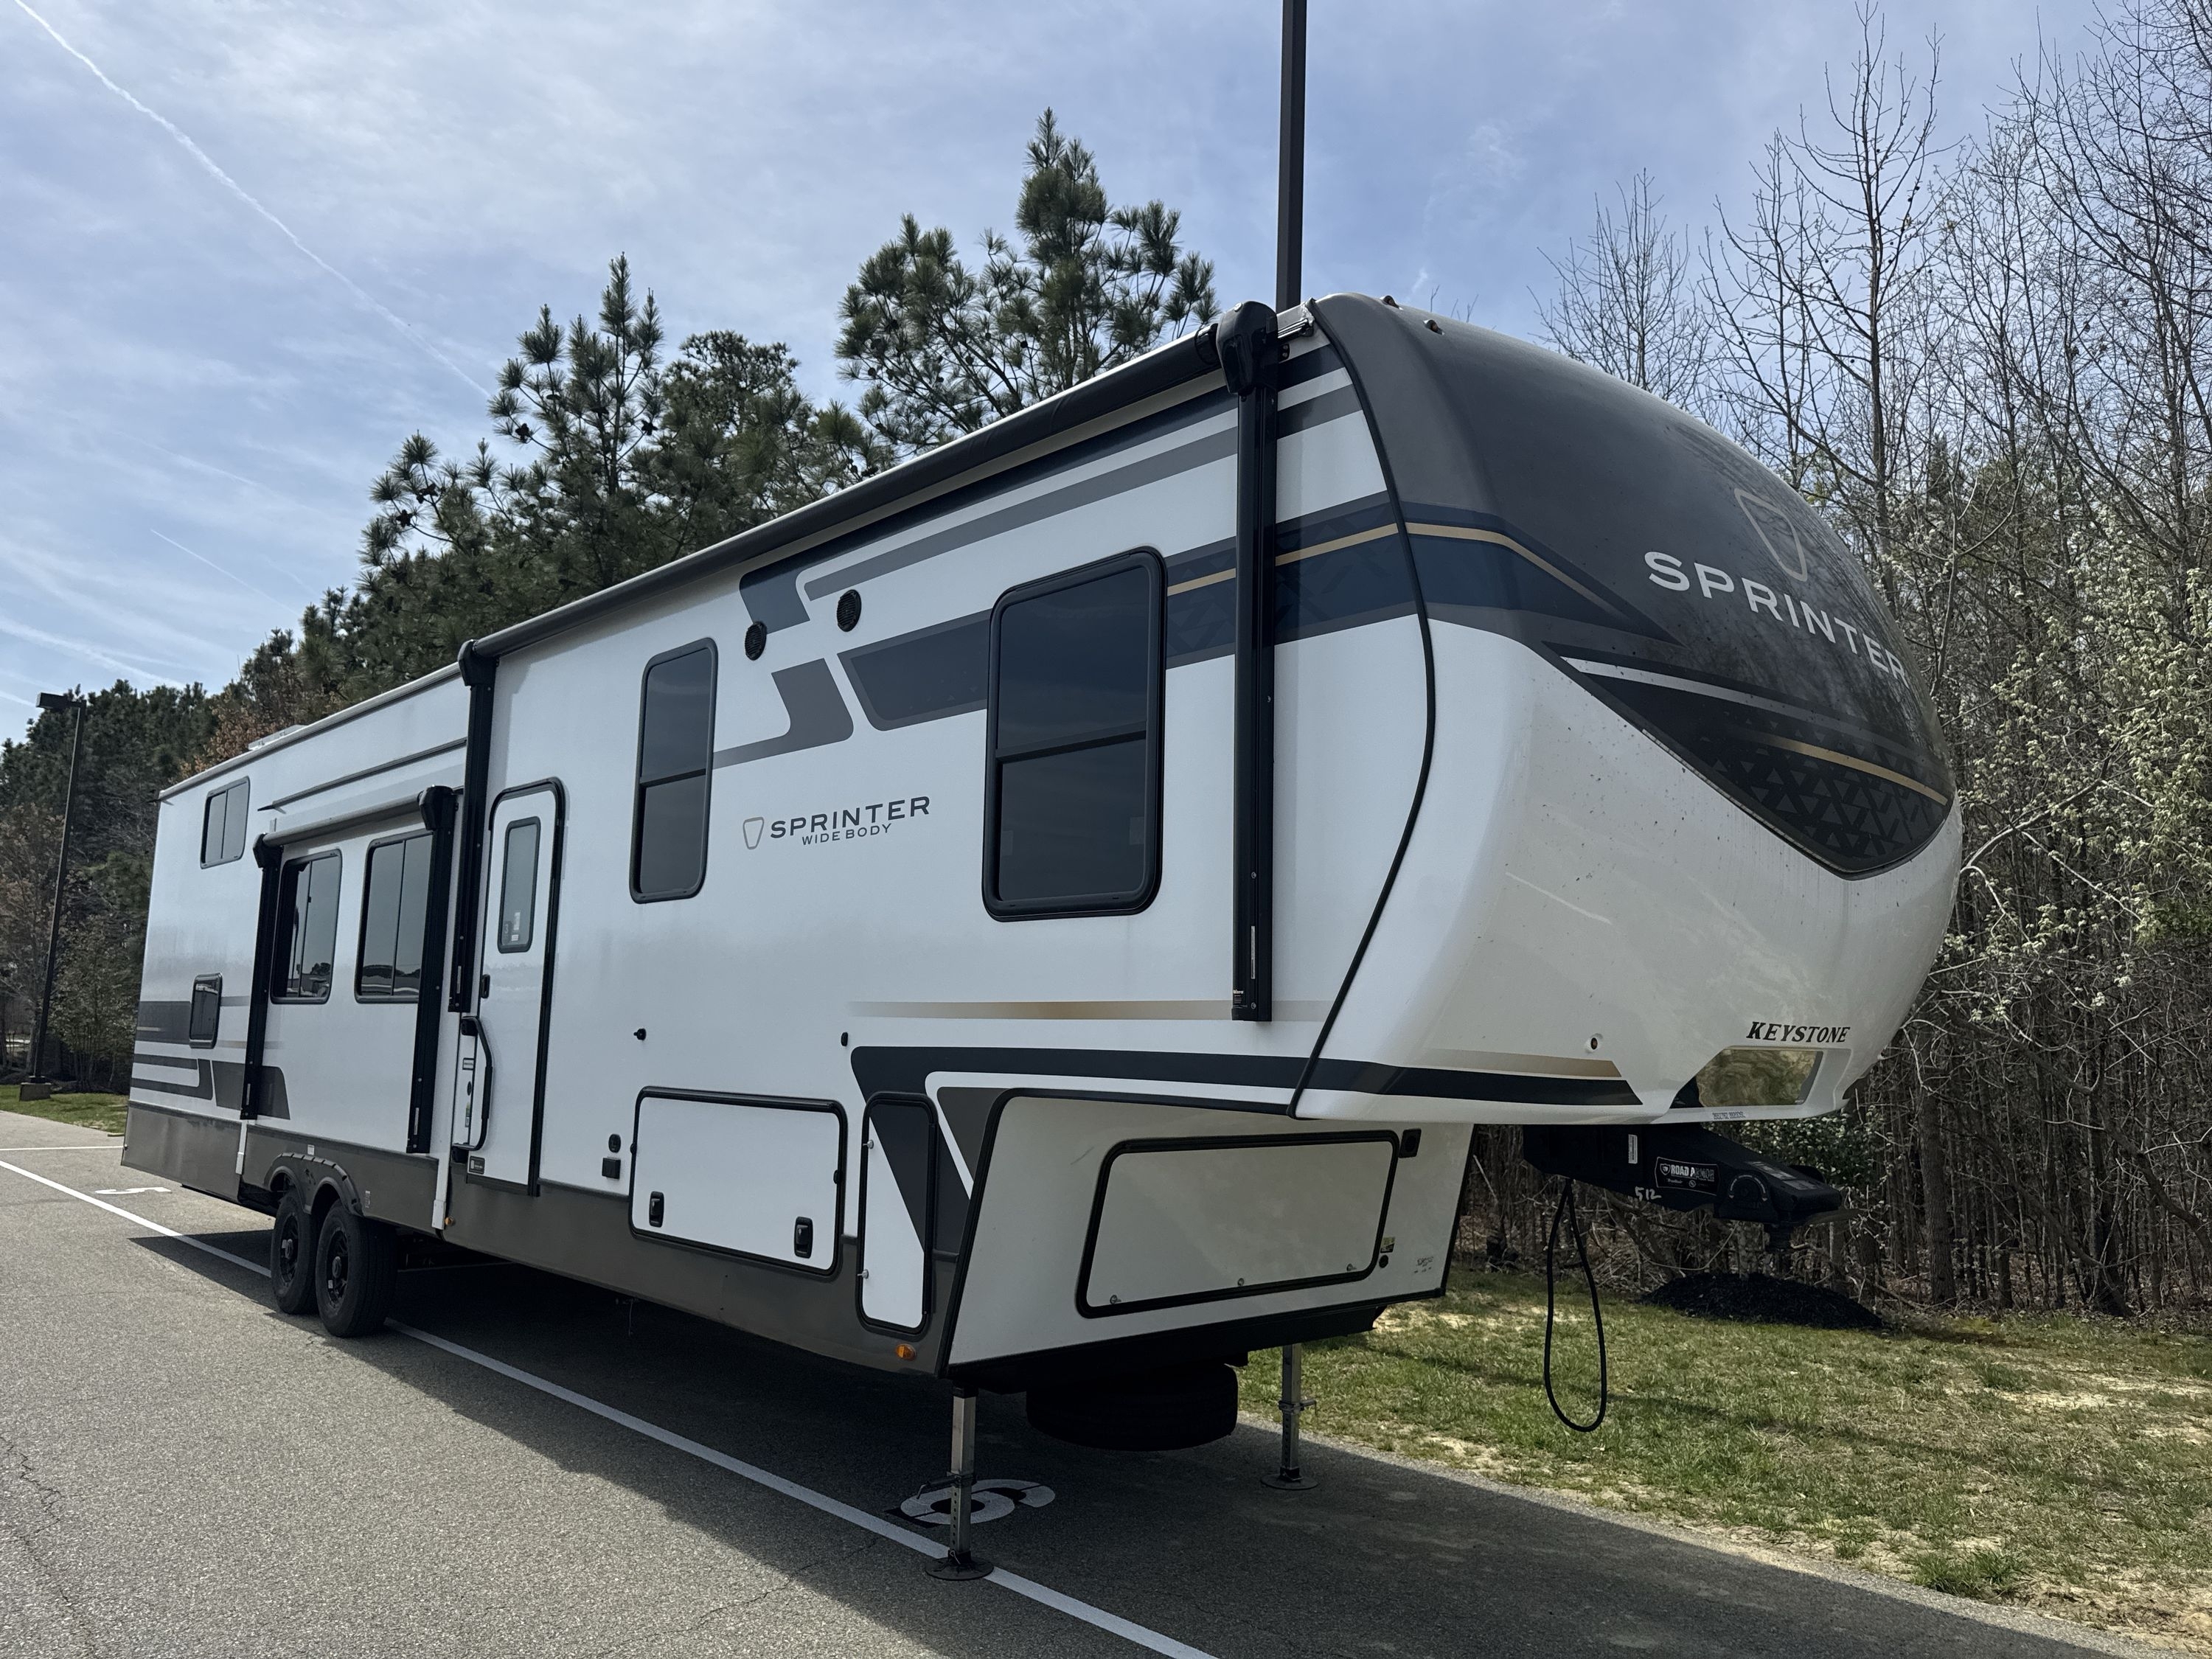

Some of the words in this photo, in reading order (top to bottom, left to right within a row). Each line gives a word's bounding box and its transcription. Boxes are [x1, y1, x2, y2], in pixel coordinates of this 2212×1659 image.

[1644, 551, 1910, 689] SPRINTER
[771, 796, 930, 838] SPRINTER
[801, 830, 841, 846] WIDE
[845, 823, 892, 839] BODY
[1746, 1021, 1851, 1044] KEYSTONE
[1671, 1164, 1689, 1177] ROAD
[1690, 1166, 1715, 1180] ARMOR
[1635, 1186, 1662, 1202] 512
